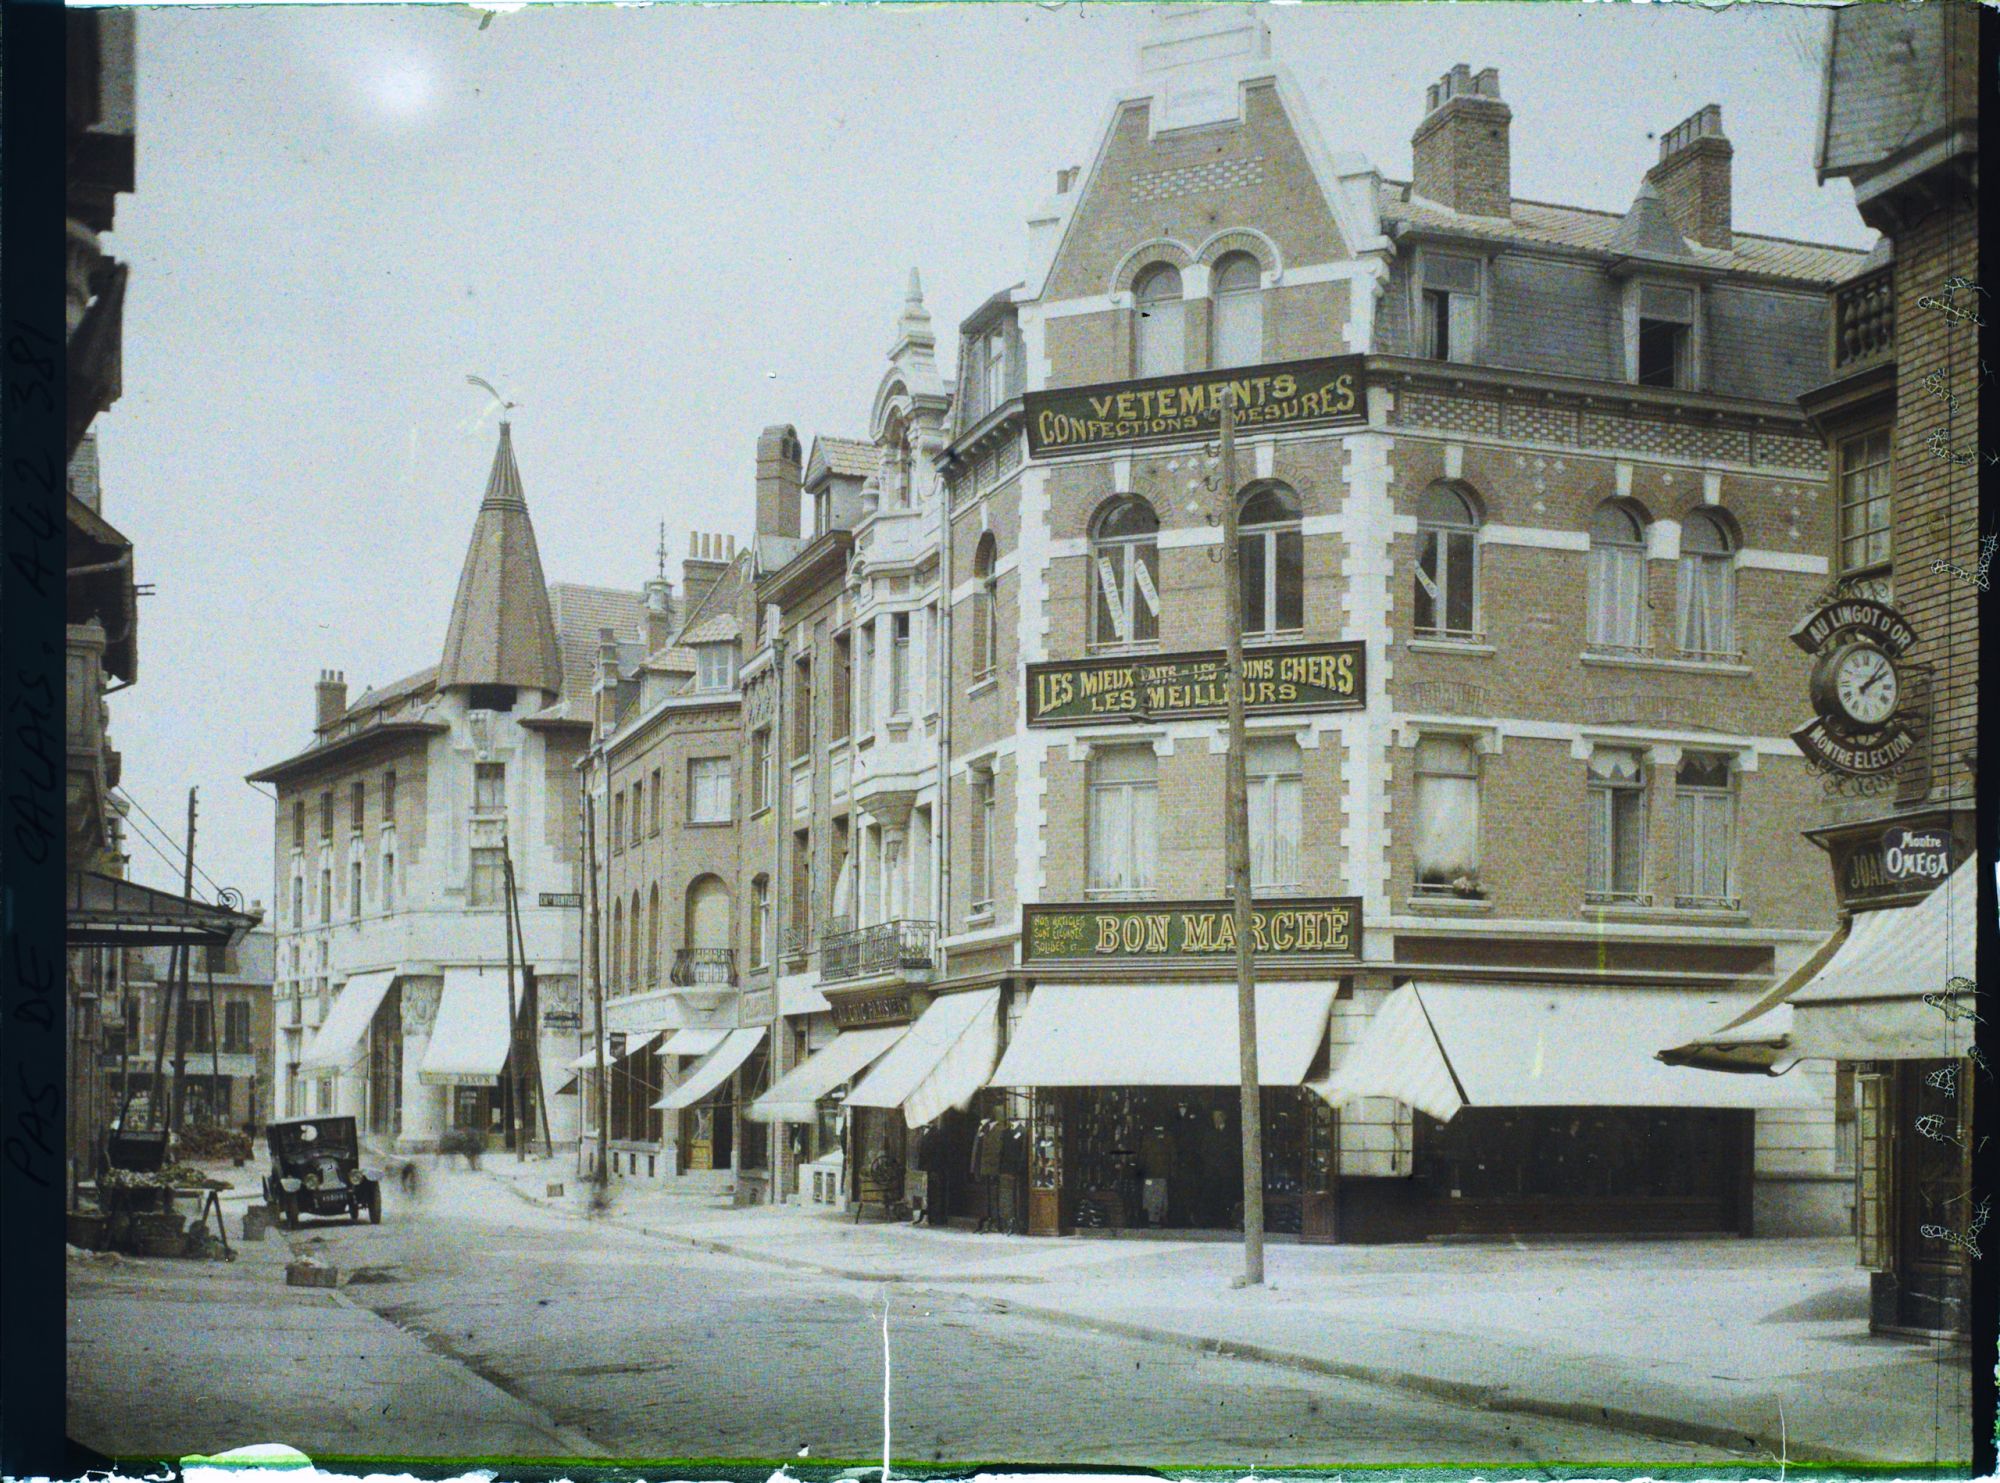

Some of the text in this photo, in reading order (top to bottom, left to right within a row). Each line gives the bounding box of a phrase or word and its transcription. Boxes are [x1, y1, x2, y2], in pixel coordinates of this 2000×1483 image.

[1038, 374, 1355, 445] CONFECTIONS MESURES
[1809, 605, 1912, 648] AU LINGOT D'OR
[1037, 673, 1073, 716] LES
[1080, 669, 1134, 698] MIEUX
[1193, 663, 1218, 681] LES
[1224, 659, 1274, 680] OINS
[1280, 653, 1354, 696] CHERS
[1092, 690, 1137, 712] LES
[1809, 725, 1853, 766] MONTRE
[1900, 831, 1941, 848] Montre
[1887, 847, 1949, 878] OMEGA
[1095, 914, 1170, 953] BON
[12, 932, 56, 1034] DE
[3, 1080, 58, 1188] PAS
